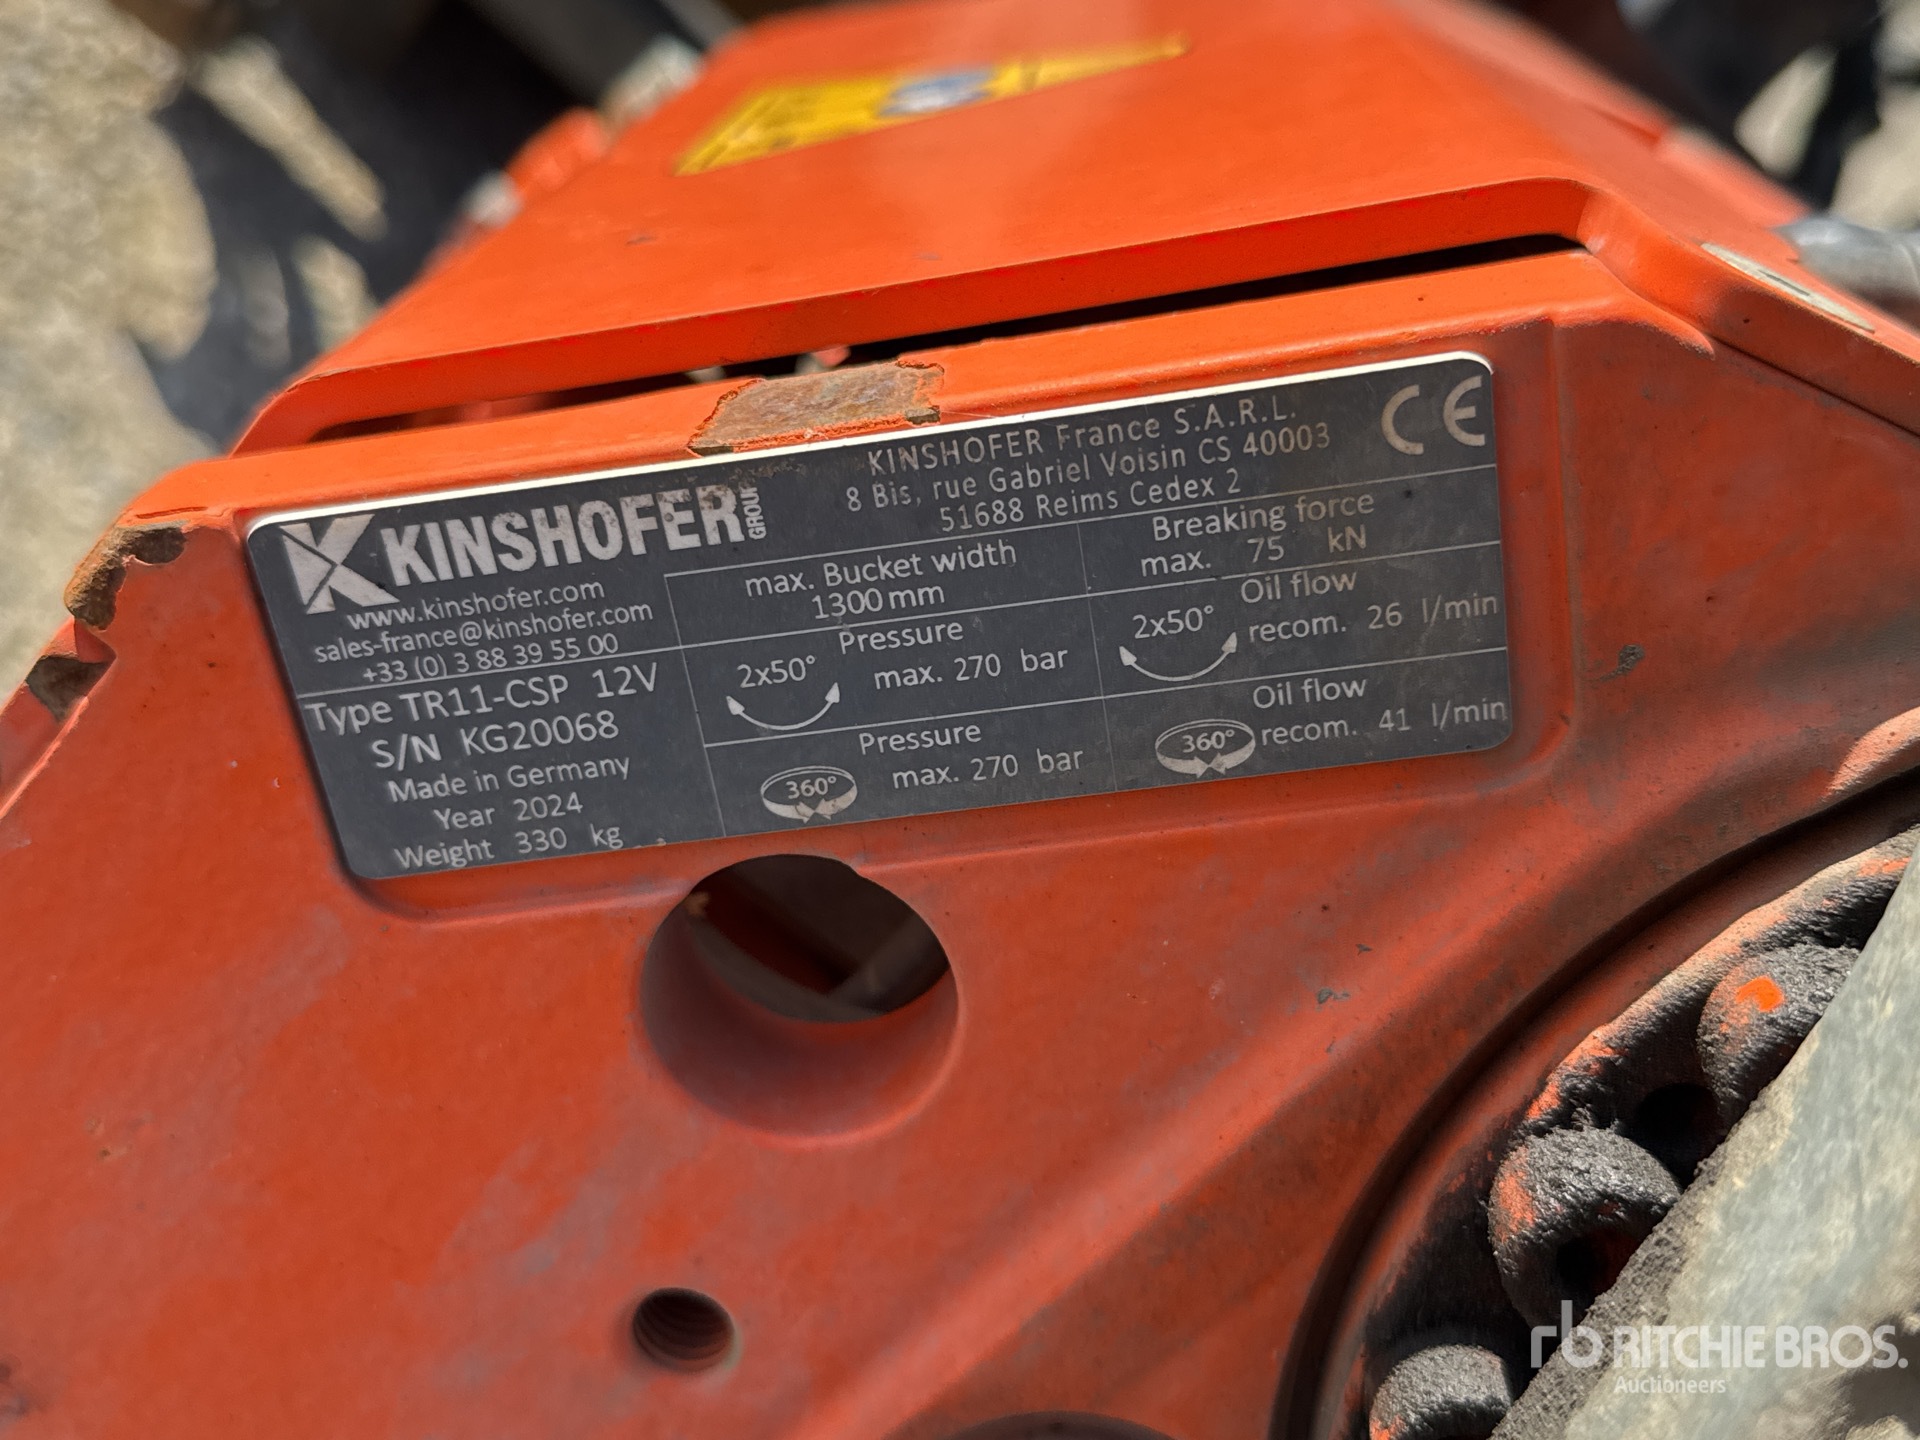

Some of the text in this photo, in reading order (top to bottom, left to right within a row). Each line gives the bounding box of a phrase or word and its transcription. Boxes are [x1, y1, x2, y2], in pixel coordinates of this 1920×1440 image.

[867, 399, 1296, 476] KINSHOFER France S.A.R.L.
[1380, 375, 1486, 455] CE
[847, 422, 1331, 512] 8 Bis, rue Gabriel Voisin CS 40003
[940, 469, 1241, 533] 51688 Reims Cedex 2
[1152, 491, 1376, 542] Breaking force
[379, 484, 745, 587] KINSHOFER
[1140, 525, 1367, 577] max. 75 kN
[745, 539, 1017, 597] max. Bucket width
[1240, 570, 1358, 604] Oil flow
[347, 580, 605, 630] www.kinshofer.com
[1248, 593, 1498, 642] recom. 26 l/min
[315, 601, 653, 663] sales-france@kinshofer.com
[838, 619, 964, 655] Pressure
[363, 632, 618, 683] +33 (0) 3 88 39 55 00
[874, 647, 1069, 689] max. 270 bar
[305, 663, 659, 736] Type TR11-CSP 12V
[1253, 676, 1367, 709] Oil flow
[372, 710, 619, 772] S/N KG20068
[859, 722, 983, 755] Pressure
[1261, 698, 1506, 746] recom. 41 l/min
[388, 754, 631, 803] Made in Germany
[892, 748, 1084, 790] max. 270 bar
[434, 792, 583, 830] Year 2024
[394, 824, 624, 870] Weight 330 kg
